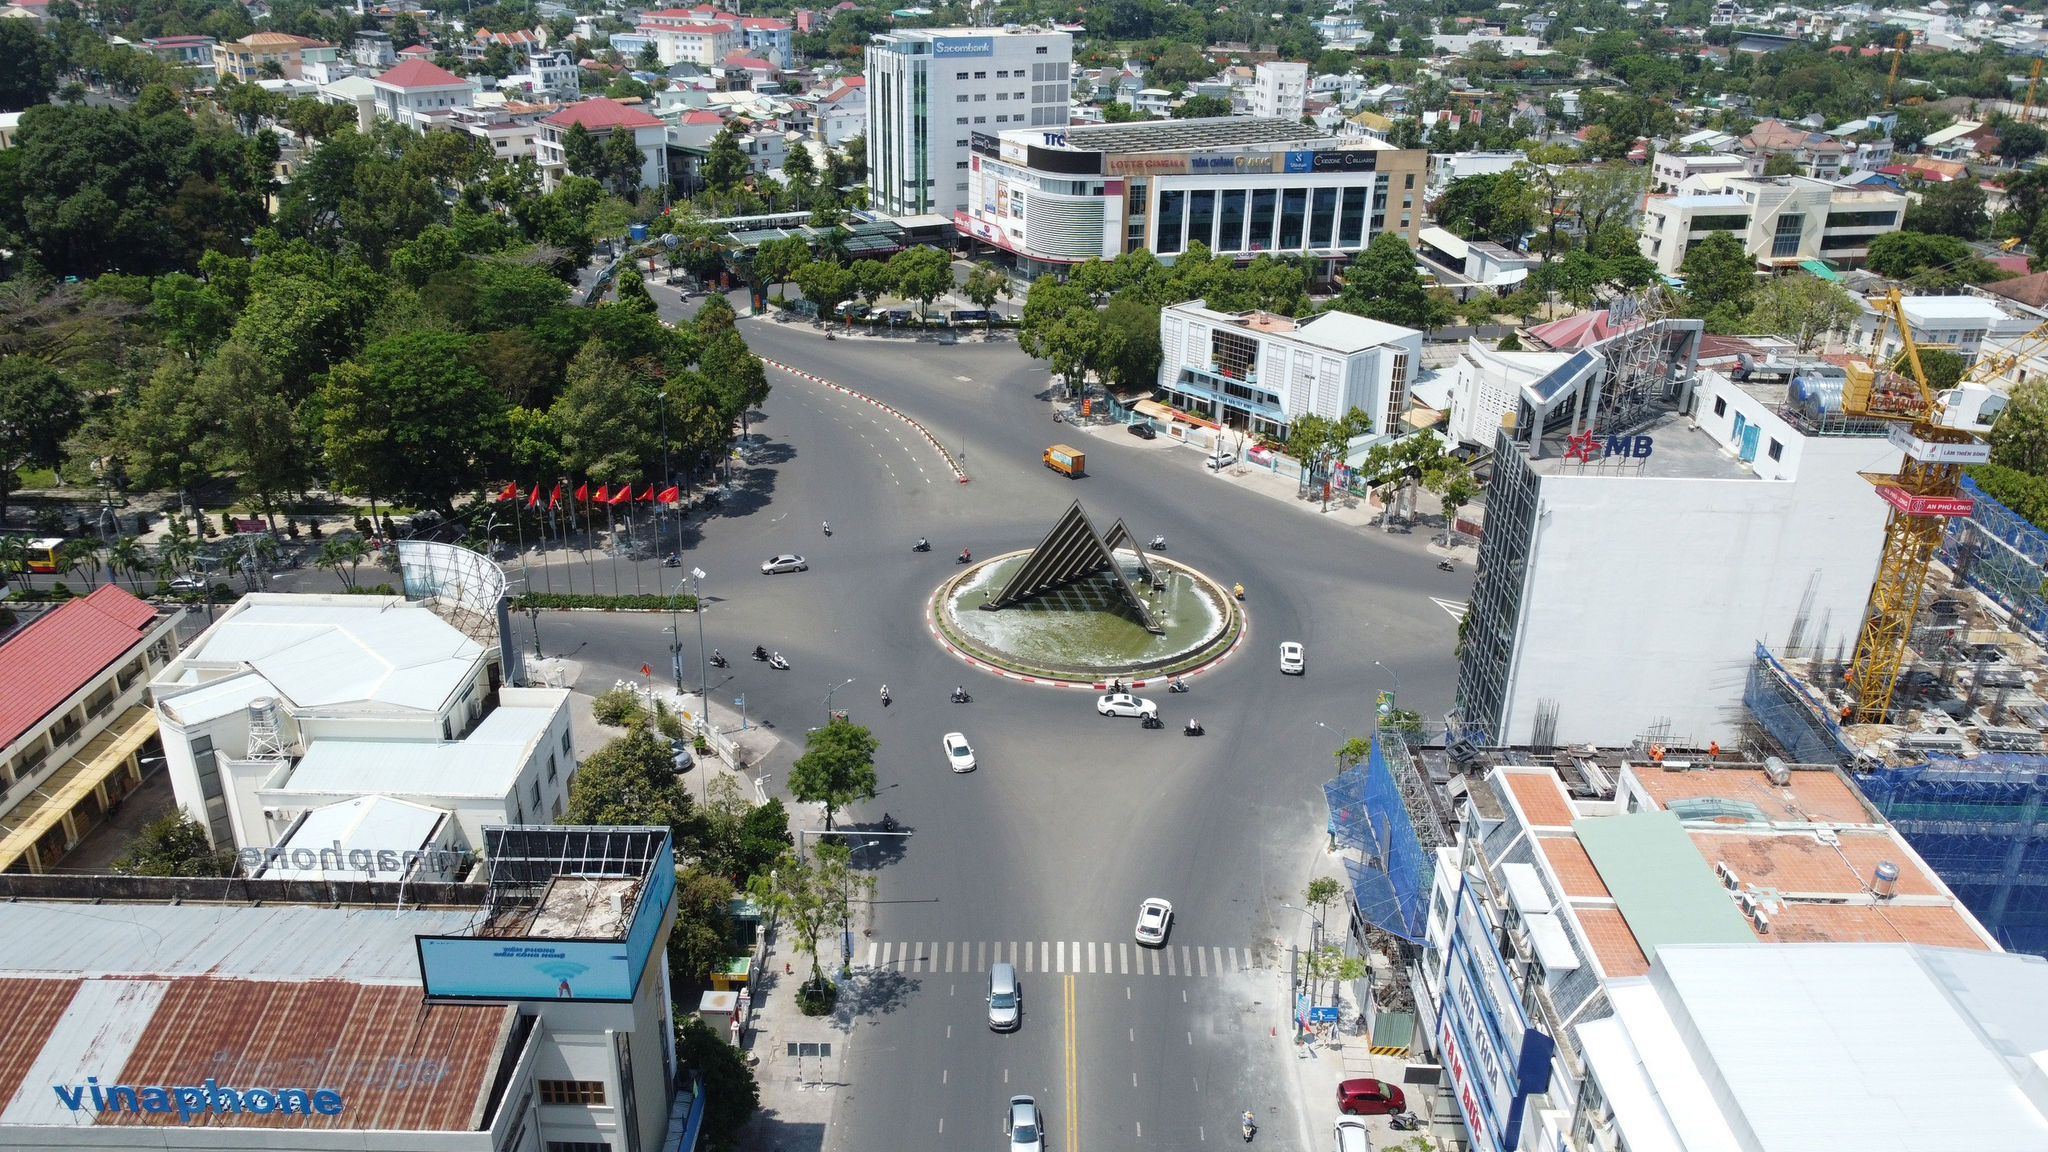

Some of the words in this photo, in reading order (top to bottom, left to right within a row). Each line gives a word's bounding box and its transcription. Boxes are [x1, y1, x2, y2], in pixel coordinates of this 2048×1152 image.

[936, 41, 990, 53] Sacombank
[1043, 132, 1066, 147] TTC
[1110, 160, 1143, 169] LOTTE
[1145, 159, 1185, 168] CINEMA
[1604, 435, 1654, 458] MB
[1458, 976, 1475, 1029] NHA
[1475, 1021, 1499, 1094] KHOA
[53, 1076, 343, 1123] vinaphone
